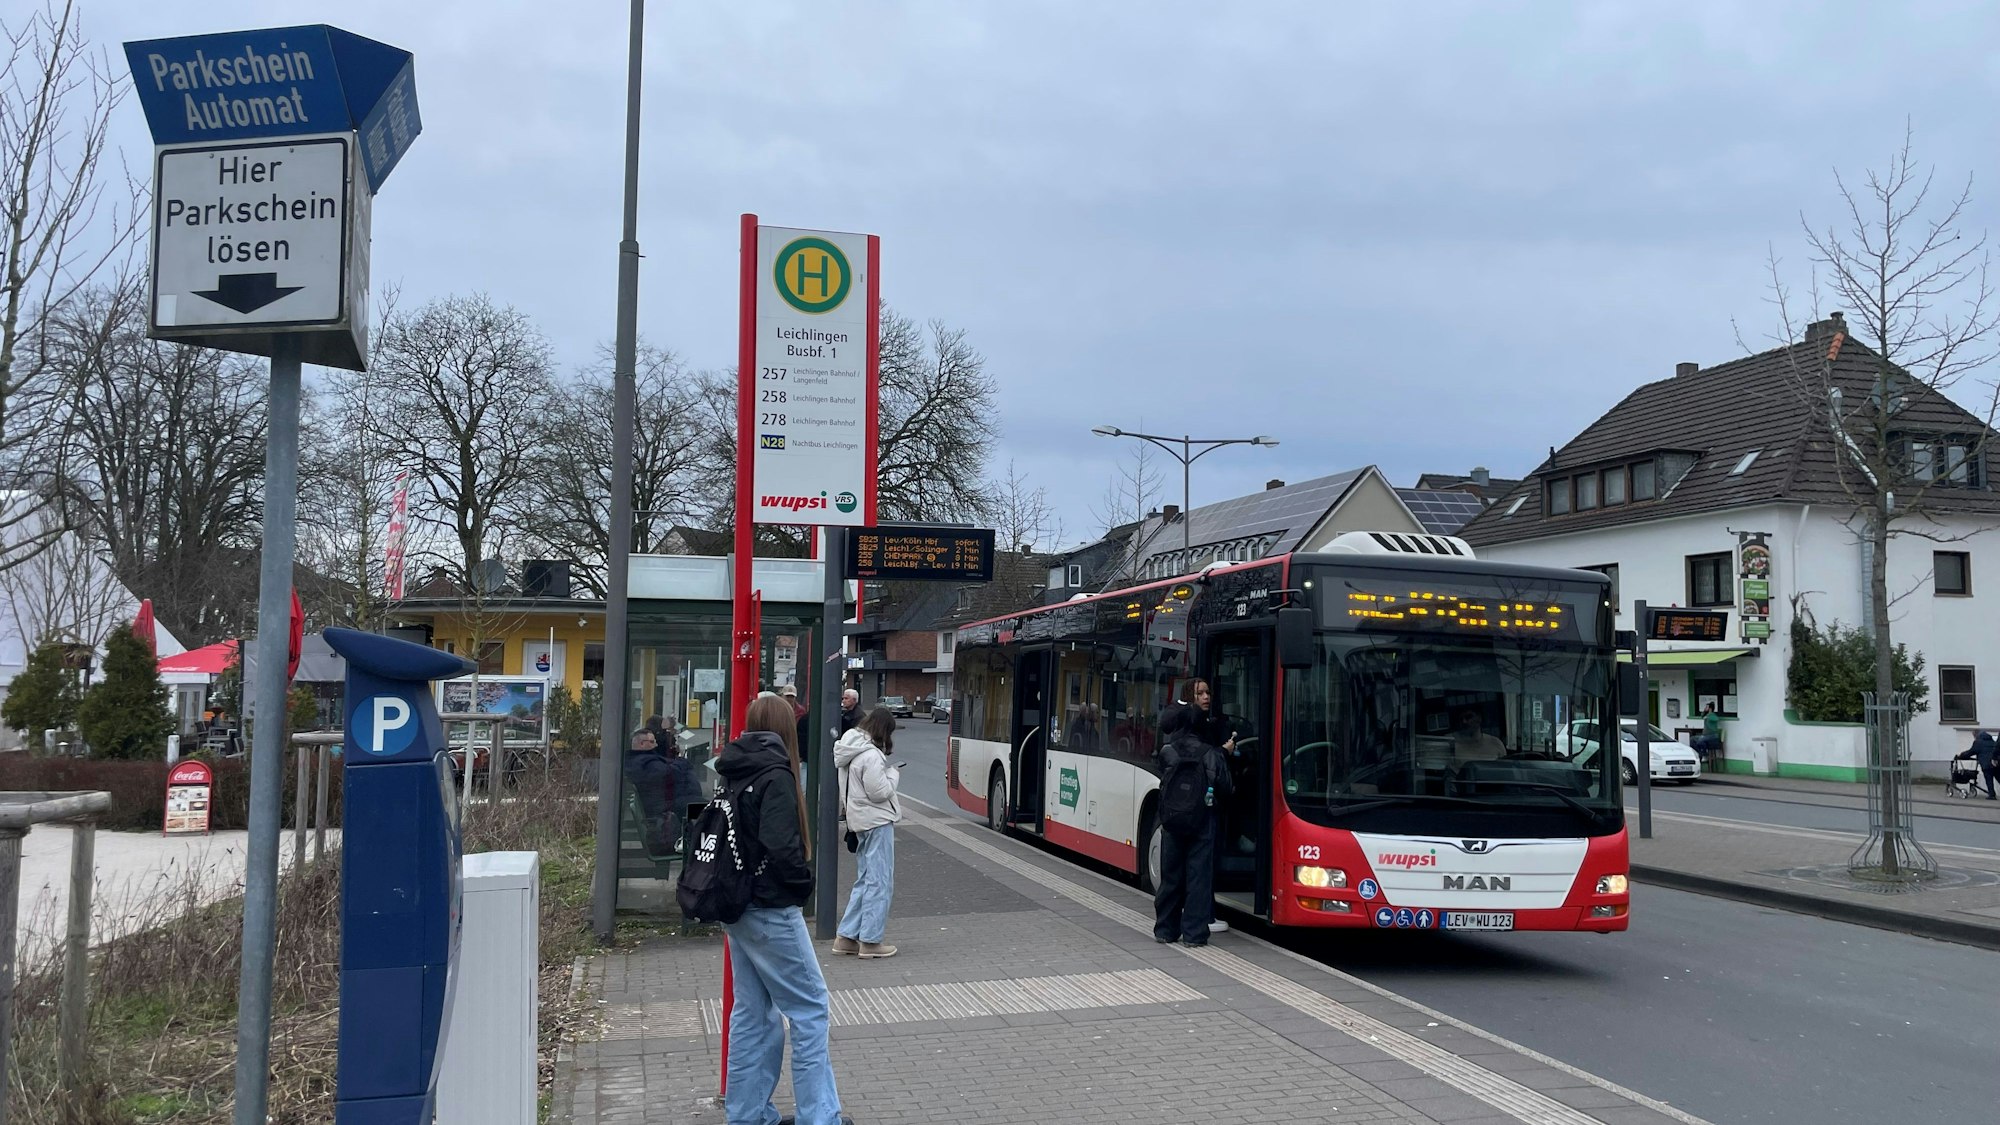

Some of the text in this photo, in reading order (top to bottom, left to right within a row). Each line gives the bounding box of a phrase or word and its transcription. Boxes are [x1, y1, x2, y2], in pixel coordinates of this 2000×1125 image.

[148, 43, 314, 92] Parkschein
[184, 87, 308, 131] Automat
[219, 156, 282, 185] Hier
[166, 192, 336, 227] Parkschein
[207, 236, 290, 264] lösen
[797, 253, 829, 297] H
[777, 327, 848, 345] Leichlingen
[787, 344, 836, 359] Busbf. 1
[762, 367, 787, 380] 257
[793, 368, 829, 377] Leichlingen
[830, 369, 857, 378] Bahnhof
[793, 377, 828, 386] Langenfeld
[762, 390, 856, 404] 258 Leichlingen Bahnhof
[761, 413, 856, 427] 278 Leichlingen Bahnhof
[761, 436, 858, 450] N28 Nachtbus Leichlingen
[761, 490, 852, 512] wupsi VRS
[954, 539, 980, 547] sofort
[964, 546, 980, 554] Min
[932, 561, 946, 569] Lev
[1250, 588, 1267, 599] MAN
[1237, 603, 1247, 616] 123
[372, 696, 411, 752] P
[1061, 773, 1078, 791] Einstieg
[1061, 790, 1073, 802] vorne
[1297, 845, 1320, 860] 123
[1378, 848, 1436, 869] wupsi
[1443, 874, 1511, 891] MAN
[1447, 914, 1512, 927] LEV WU 123
